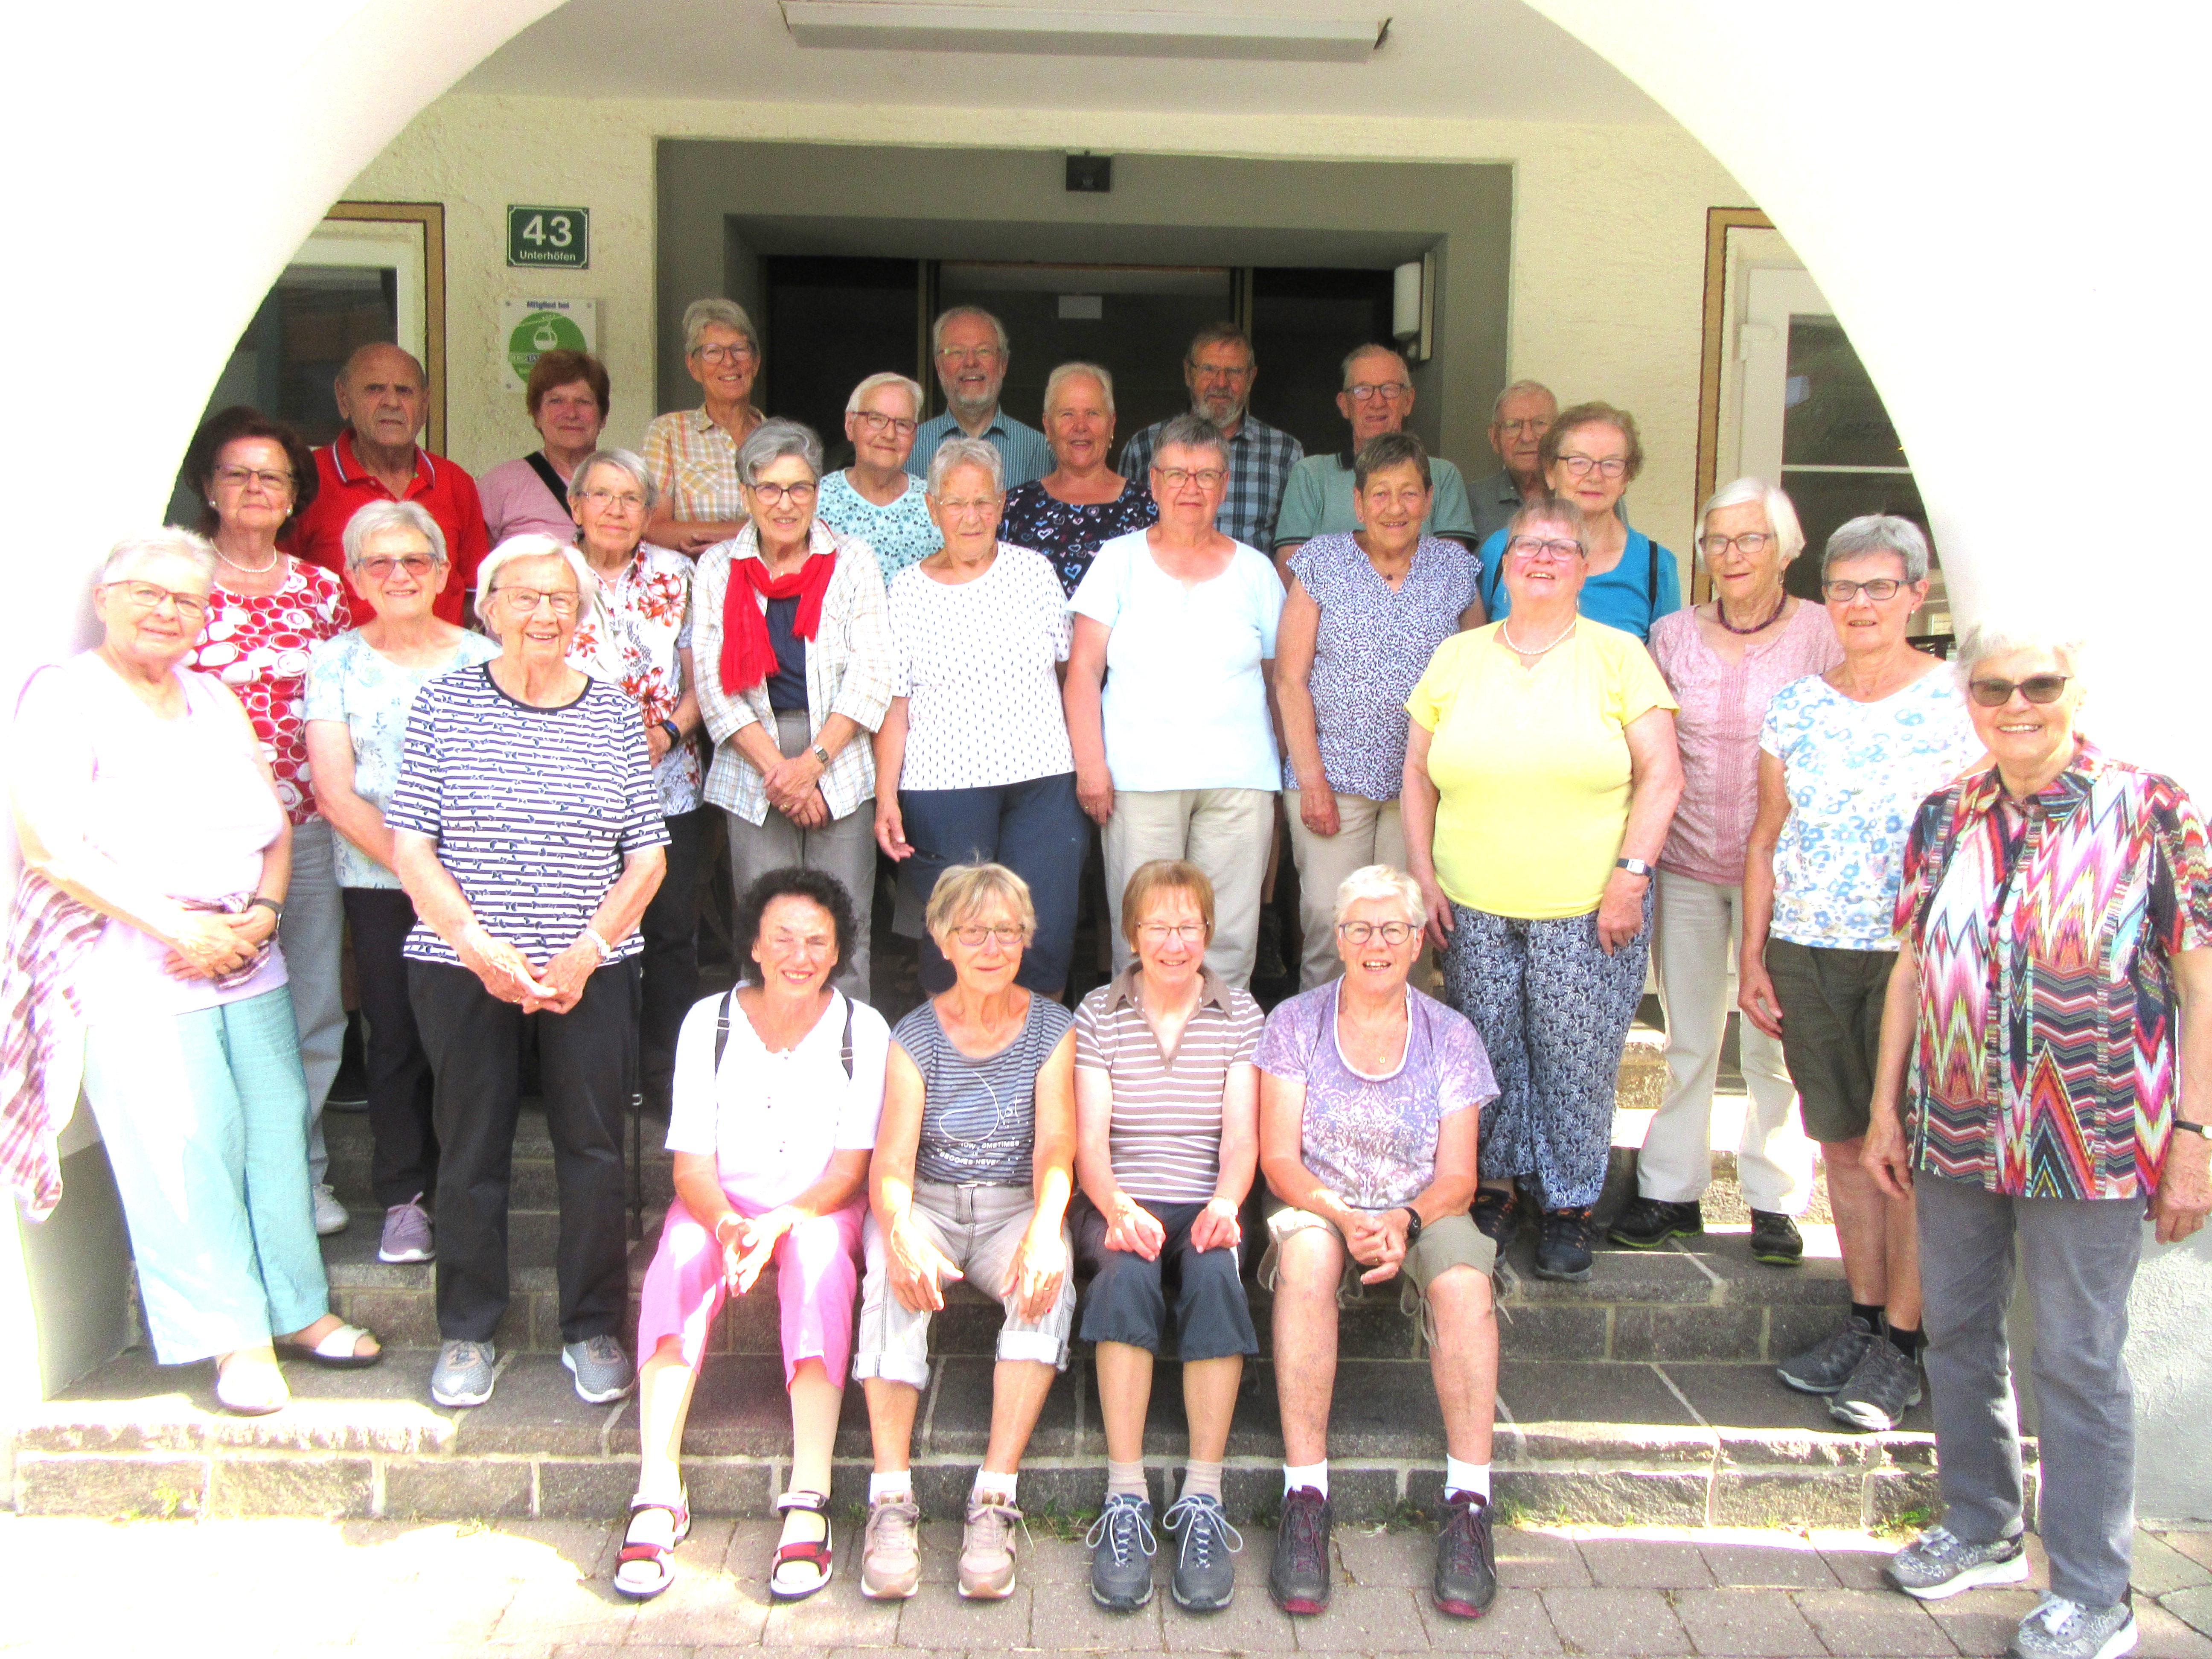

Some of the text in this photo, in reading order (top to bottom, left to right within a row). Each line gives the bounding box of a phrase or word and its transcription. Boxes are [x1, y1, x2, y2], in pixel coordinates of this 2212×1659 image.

[524, 215, 572, 247] 43
[520, 249, 576, 261] Unterhöfen
[939, 1071, 1022, 1141] Just
